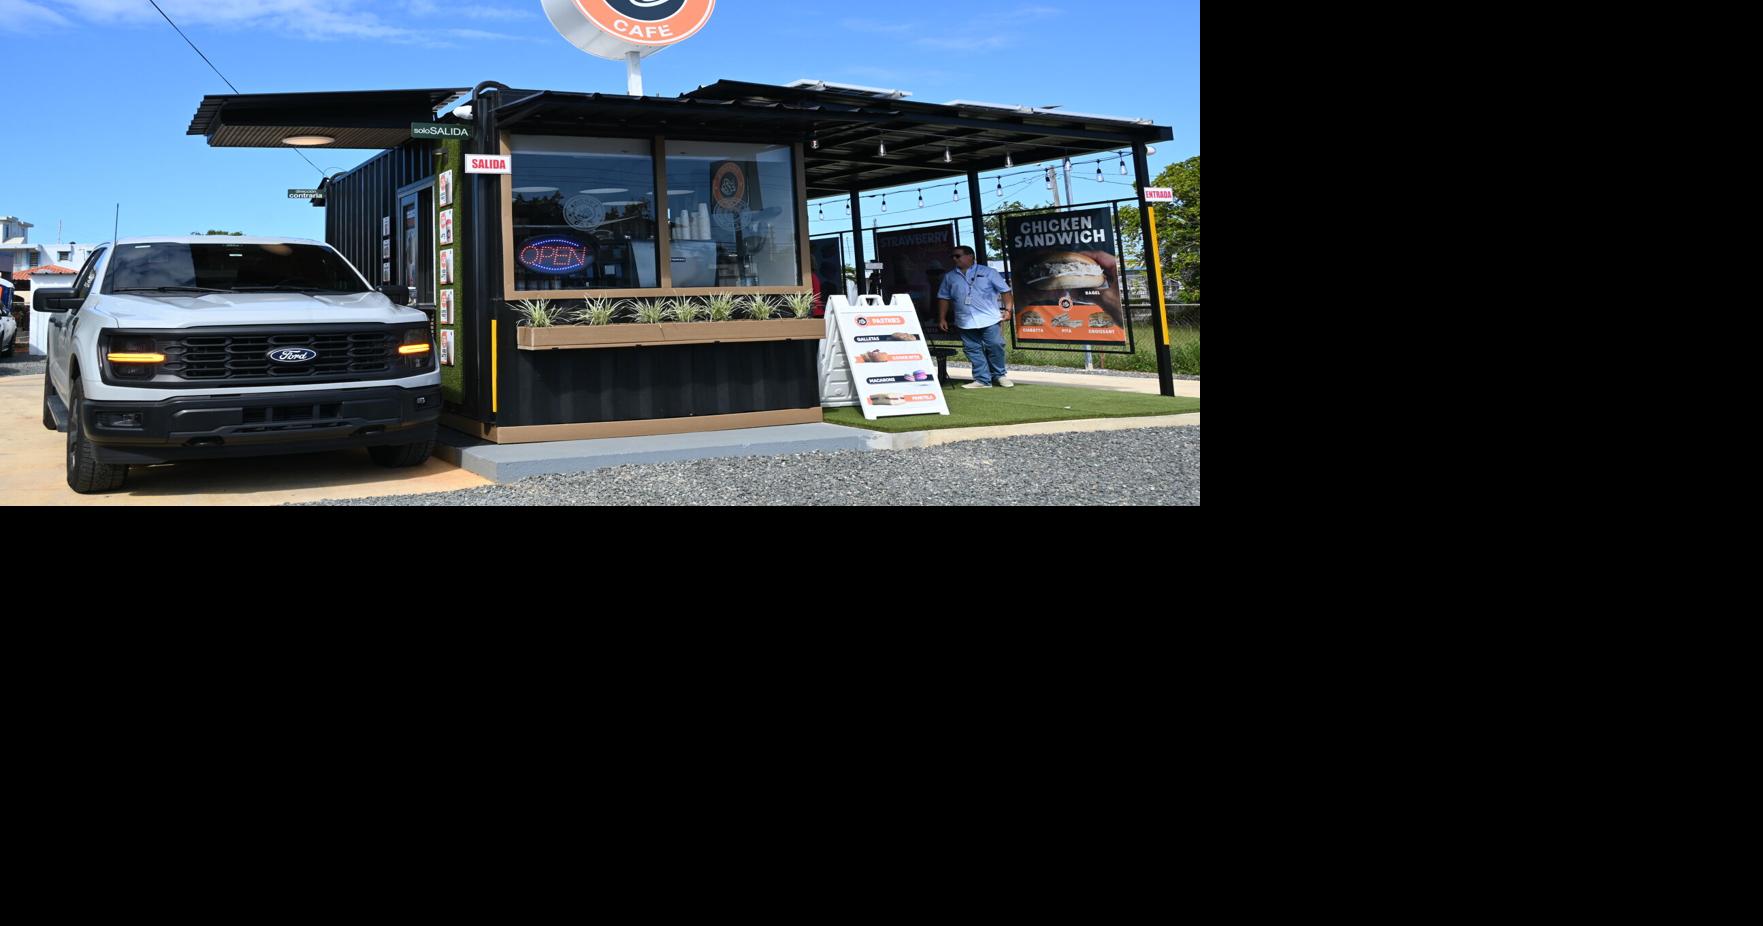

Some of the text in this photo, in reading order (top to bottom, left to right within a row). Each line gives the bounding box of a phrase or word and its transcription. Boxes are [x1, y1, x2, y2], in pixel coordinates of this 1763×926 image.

[613, 19, 673, 38] CAFE
[471, 159, 506, 169] SALIDA
[1145, 190, 1172, 199] ENTRADA
[1020, 216, 1092, 234] CHICKEN
[881, 232, 947, 247] STRAWBERRY
[1014, 229, 1106, 248] SANDWICH
[520, 246, 587, 266] OPEN
[279, 350, 307, 360] Ford
